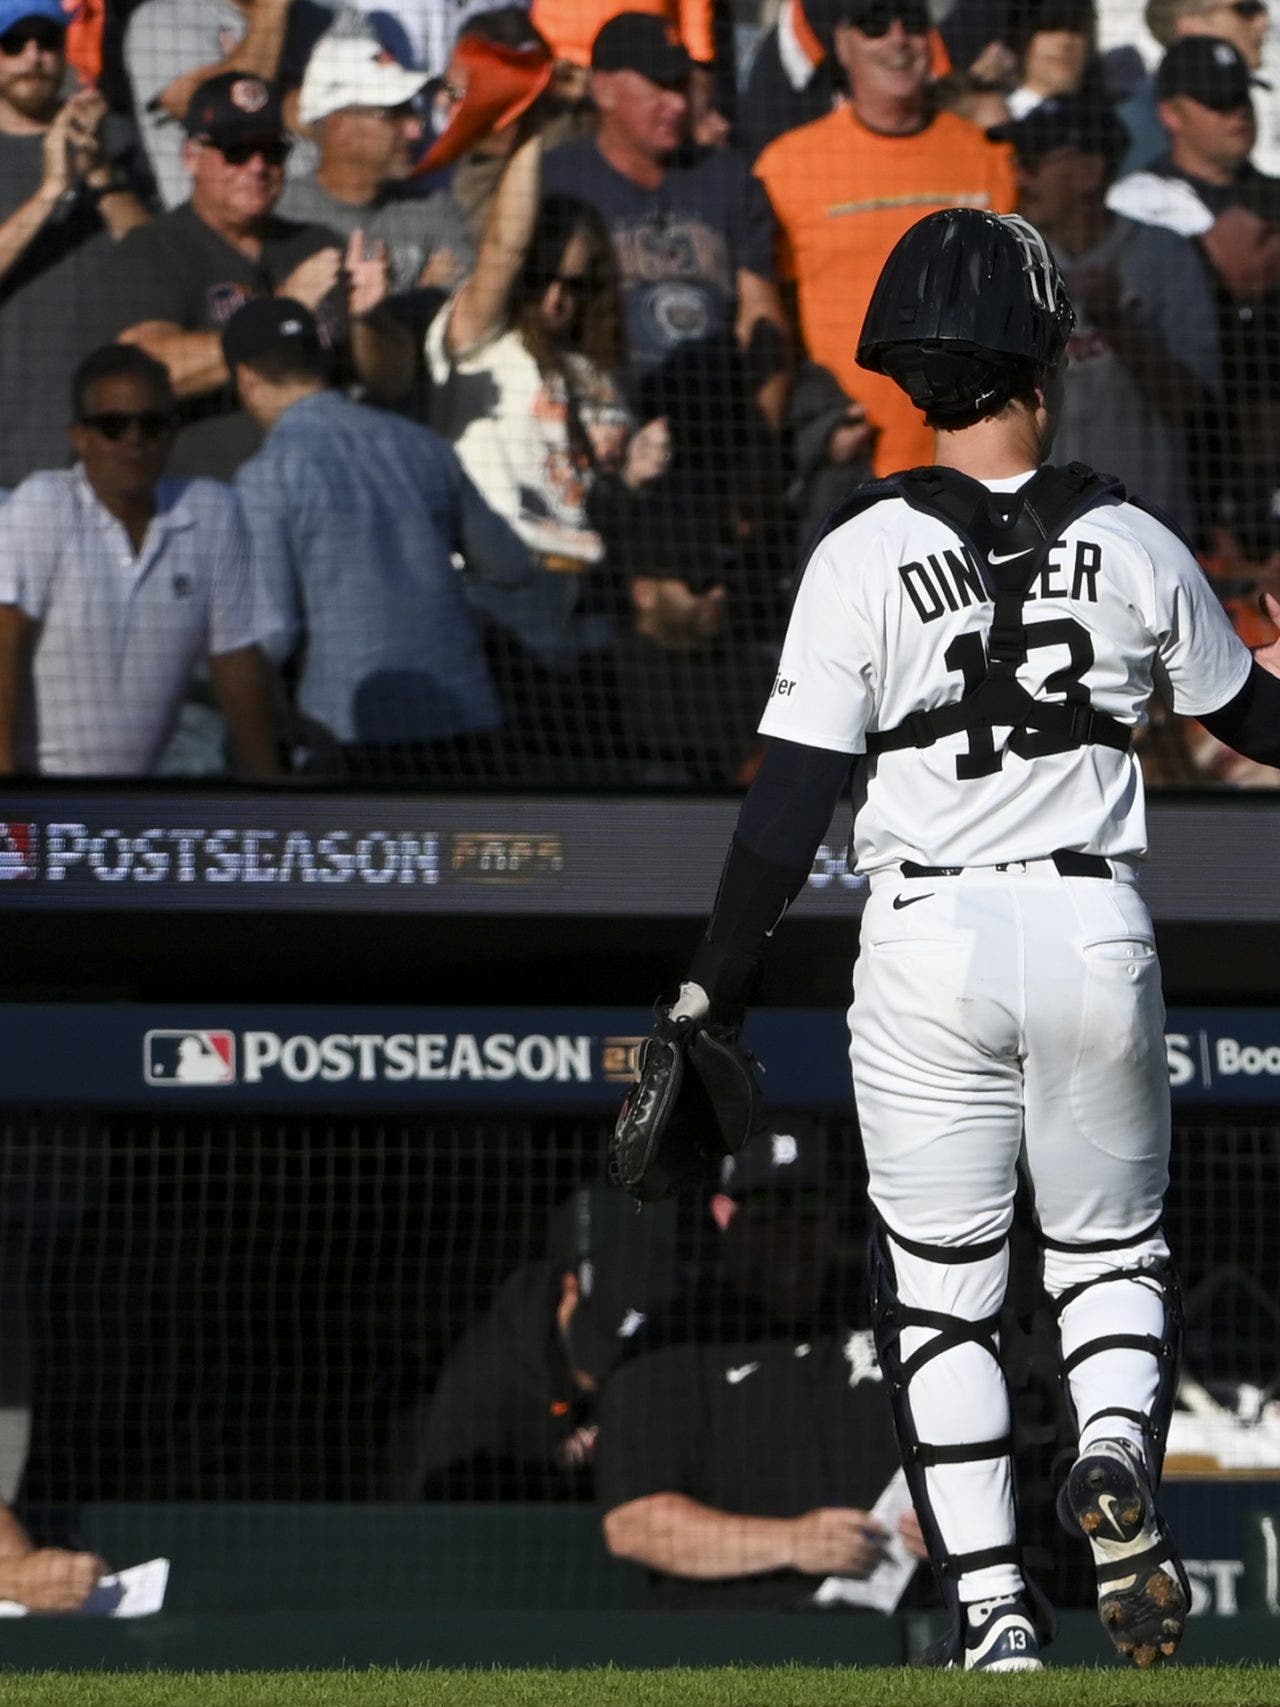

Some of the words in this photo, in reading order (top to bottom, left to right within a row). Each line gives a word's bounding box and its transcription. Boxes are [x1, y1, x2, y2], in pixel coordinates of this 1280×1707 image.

[897, 540, 1101, 624] DINER
[242, 1031, 592, 1083] POSTSEASON
[1007, 1629, 1027, 1651] 13
